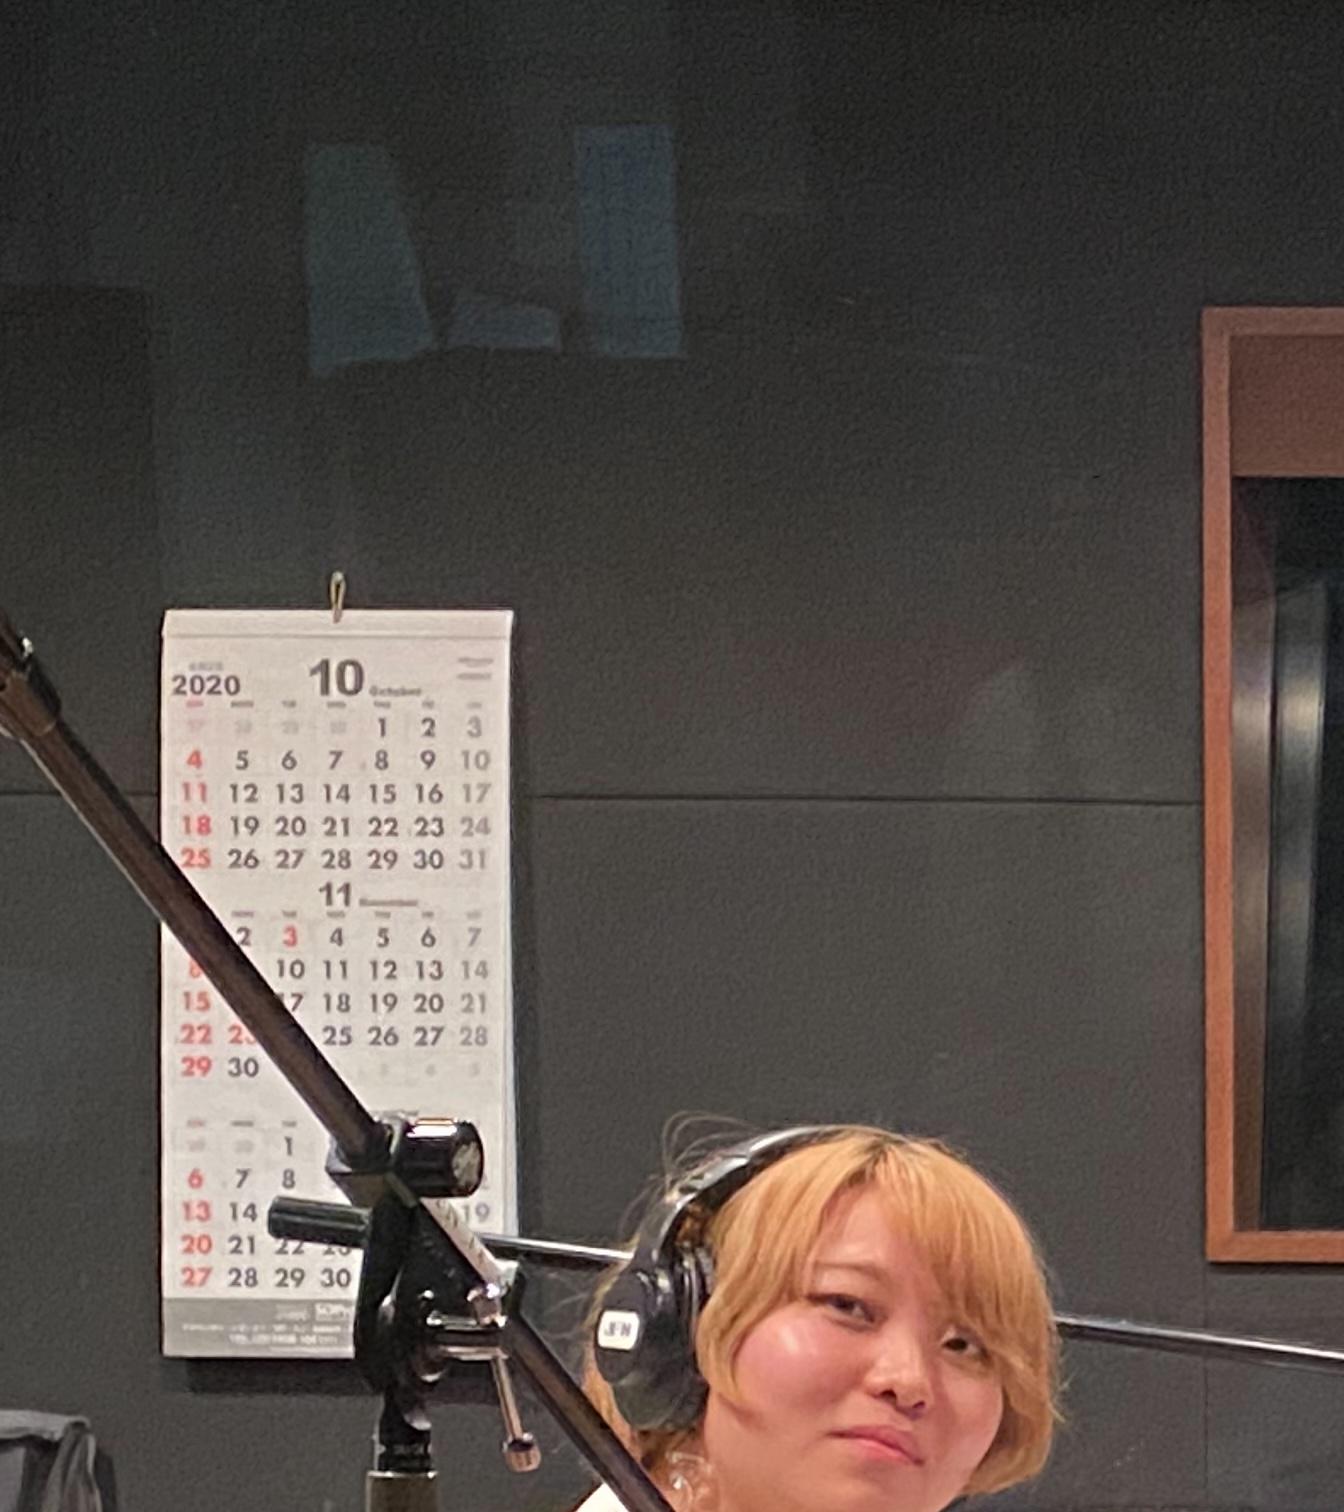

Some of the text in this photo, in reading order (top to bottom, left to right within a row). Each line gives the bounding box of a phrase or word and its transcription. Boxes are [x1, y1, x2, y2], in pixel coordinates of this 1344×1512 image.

[173, 675, 240, 696] 2020
[309, 659, 364, 696] 10
[379, 718, 386, 737] 1
[422, 717, 435, 737] 2
[467, 716, 482, 738] 3
[187, 750, 491, 771] 4 5 6 7 8 9 10
[182, 782, 491, 804] 11 12 13 14 15 16 17
[184, 815, 491, 837] 18 19 20 21 22 23 24
[181, 849, 485, 870] 25 26 27 28 29 30 31
[319, 882, 351, 907] 11
[236, 926, 481, 948] 2 3 4 5 6 7
[277, 959, 305, 979] 10
[324, 960, 347, 979] 11
[370, 960, 397, 980] 12
[417, 960, 443, 980] 13
[462, 960, 488, 980] 14
[183, 991, 211, 1012] 15
[324, 993, 350, 1013] 18
[371, 993, 398, 1012] 19
[414, 993, 444, 1013] 20
[461, 992, 486, 1014] 21
[181, 1024, 212, 1044] 22
[323, 1026, 352, 1046] 25
[368, 1026, 399, 1046] 26
[415, 1026, 444, 1046] 27
[460, 1025, 488, 1046] 28
[182, 1056, 259, 1077] 29 30
[285, 1136, 292, 1156] 1
[188, 1168, 295, 1189] 6 7 8
[183, 1201, 211, 1222] 13
[230, 1202, 257, 1222] 14
[182, 1234, 212, 1255] 20
[228, 1235, 255, 1255] 21
[181, 1267, 351, 1288] 27 28 29 30
